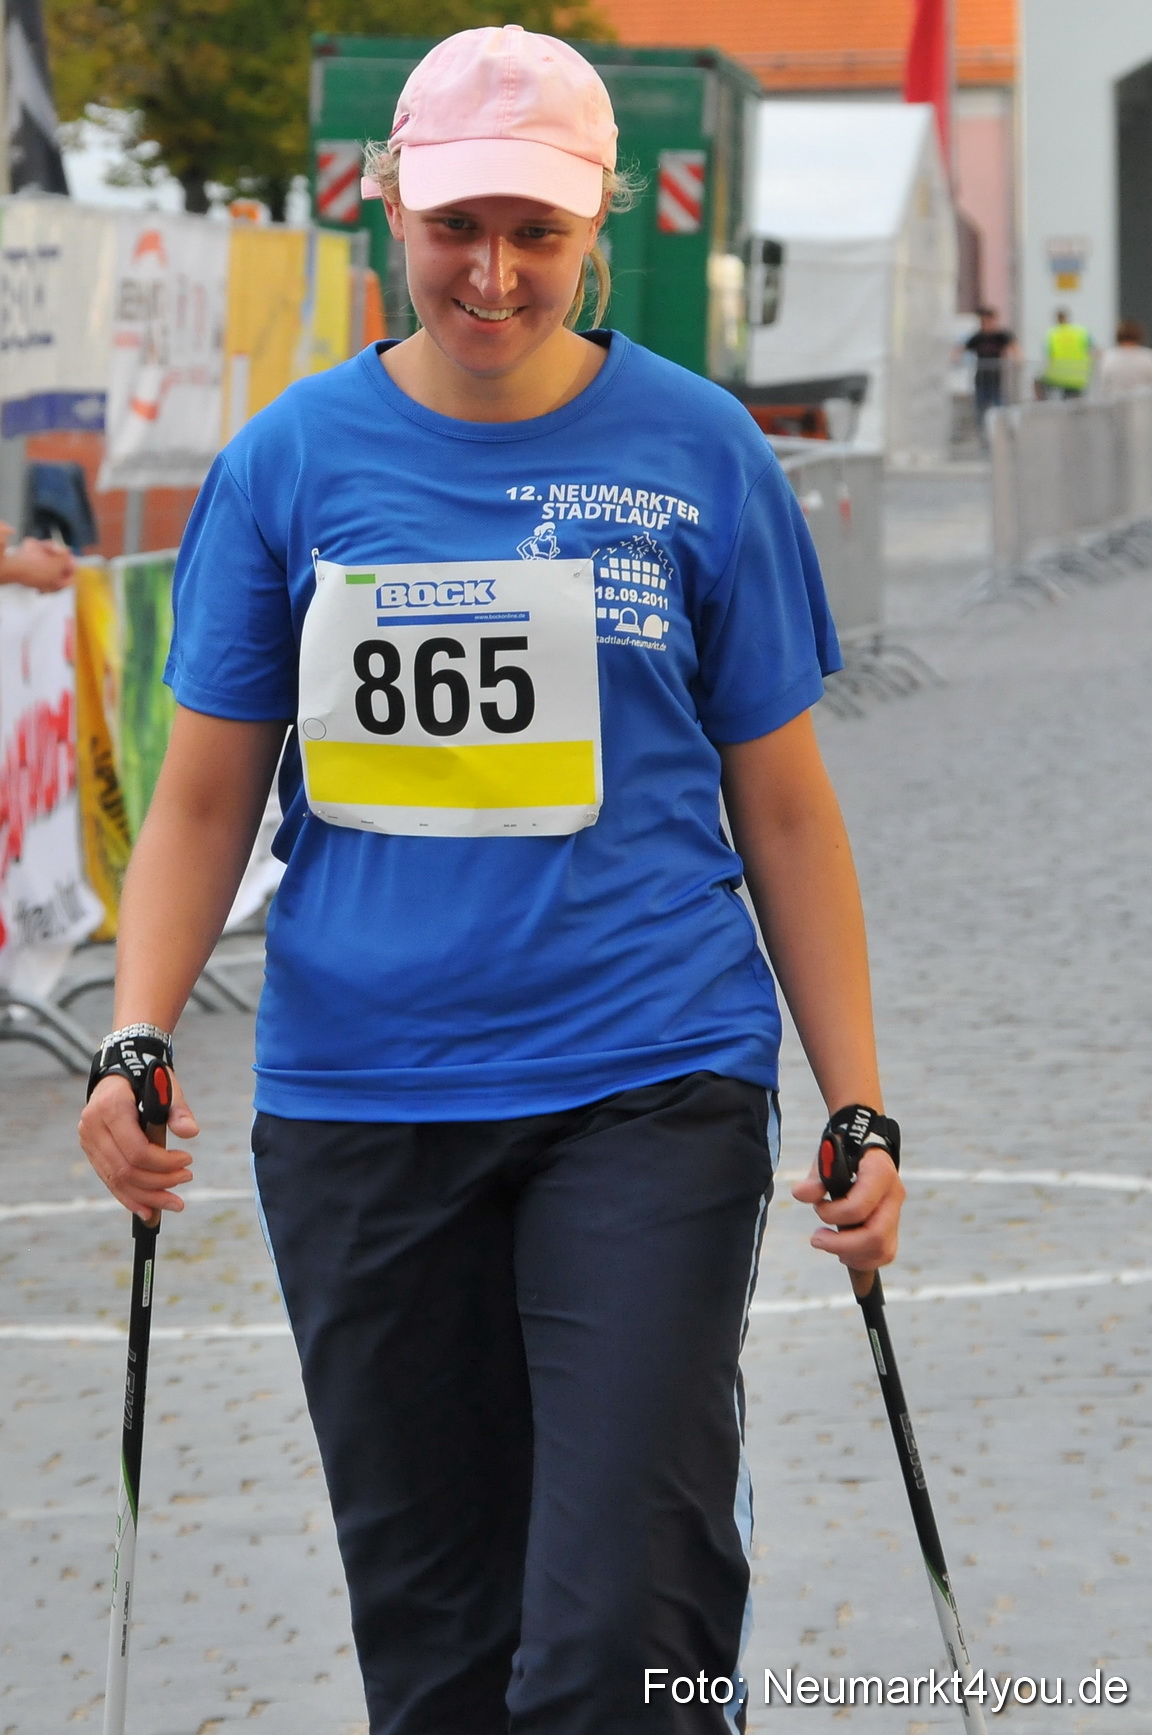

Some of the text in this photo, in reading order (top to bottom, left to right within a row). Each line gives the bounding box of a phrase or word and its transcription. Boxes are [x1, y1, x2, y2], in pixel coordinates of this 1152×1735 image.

[506, 484, 700, 525] 12. NEUMARKTER
[541, 503, 671, 530] STADTLAUF
[376, 579, 496, 609] BOCK
[353, 636, 535, 736] 865
